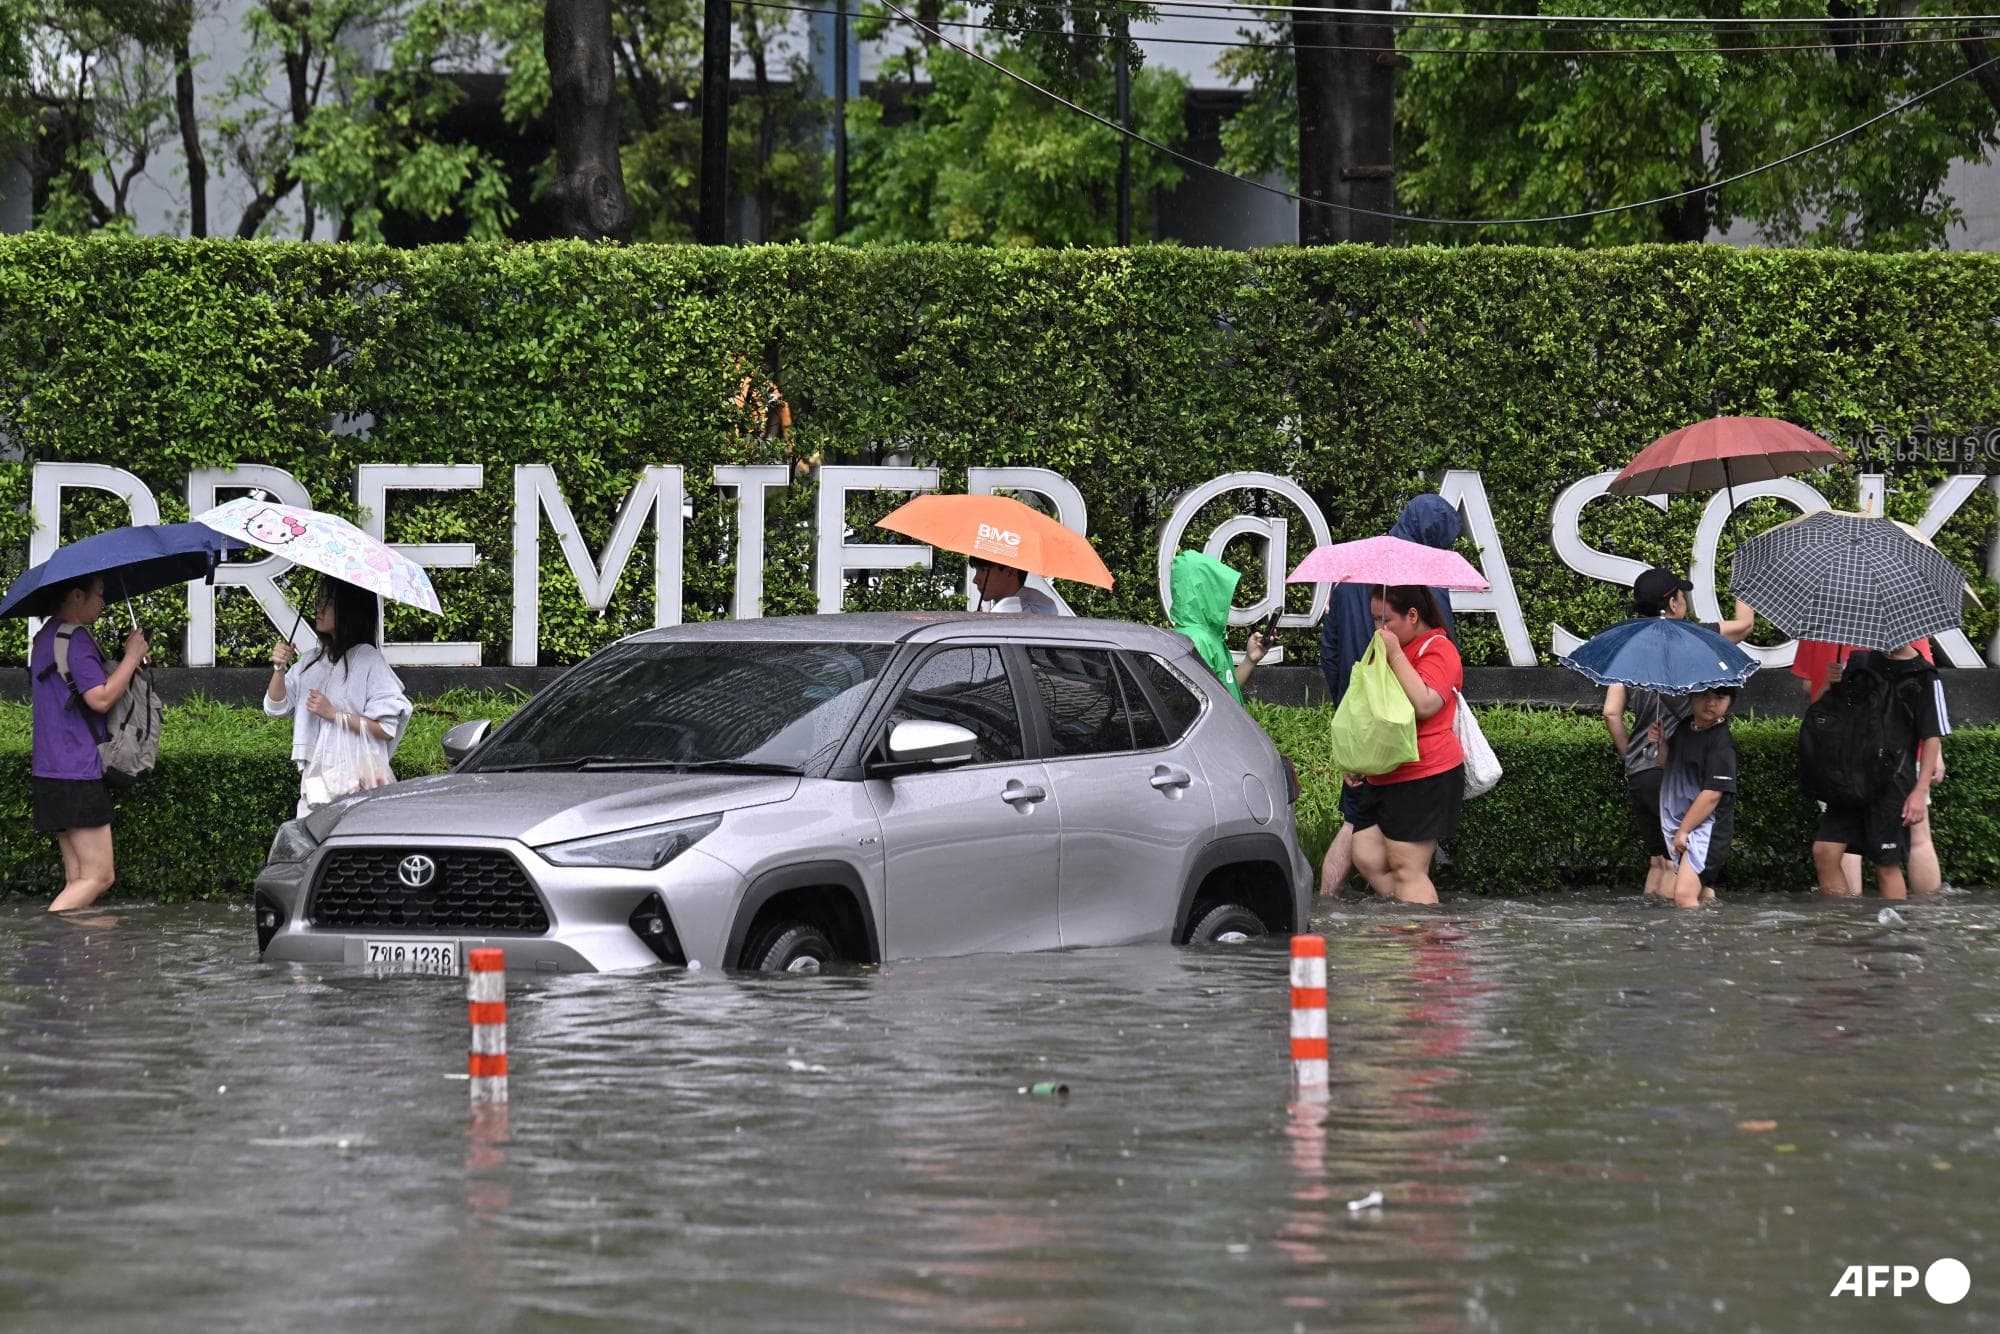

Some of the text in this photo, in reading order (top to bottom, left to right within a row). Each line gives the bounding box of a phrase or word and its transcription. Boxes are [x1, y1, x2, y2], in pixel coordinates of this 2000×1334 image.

[977, 522, 1021, 547] BMG
[28, 461, 2000, 668] PREMIER @ ASO
[411, 946, 451, 967] 1236
